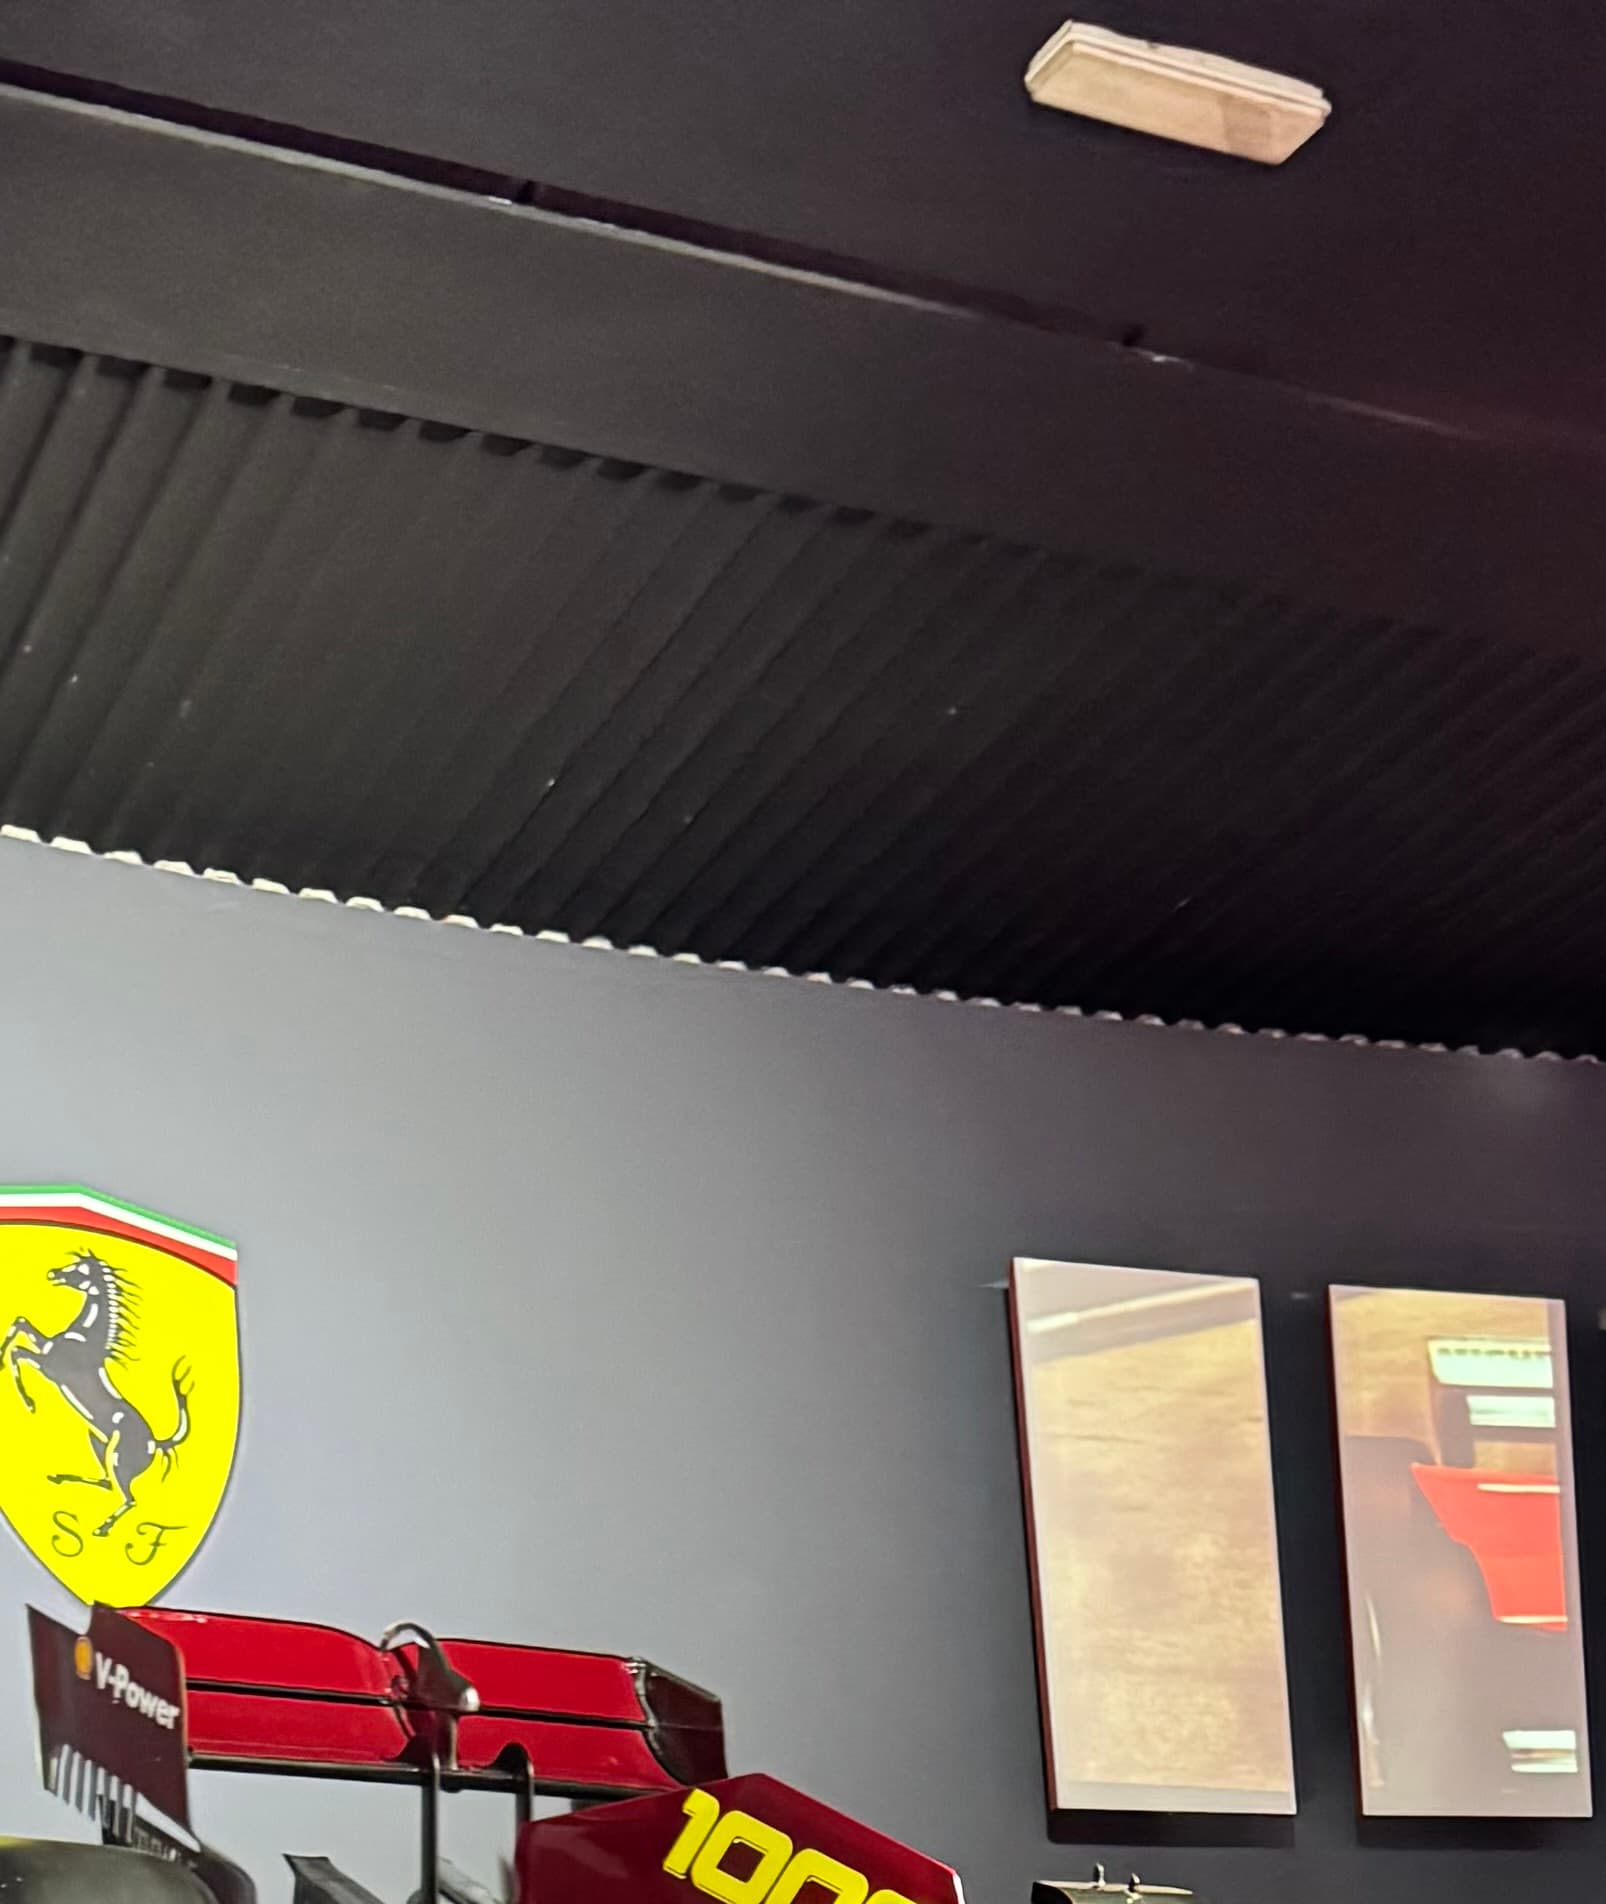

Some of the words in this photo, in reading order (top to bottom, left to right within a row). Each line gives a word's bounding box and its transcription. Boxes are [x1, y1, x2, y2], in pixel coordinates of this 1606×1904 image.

[50, 1510, 84, 1558] S
[124, 1521, 189, 1566] F
[94, 1651, 181, 1730] V-Power
